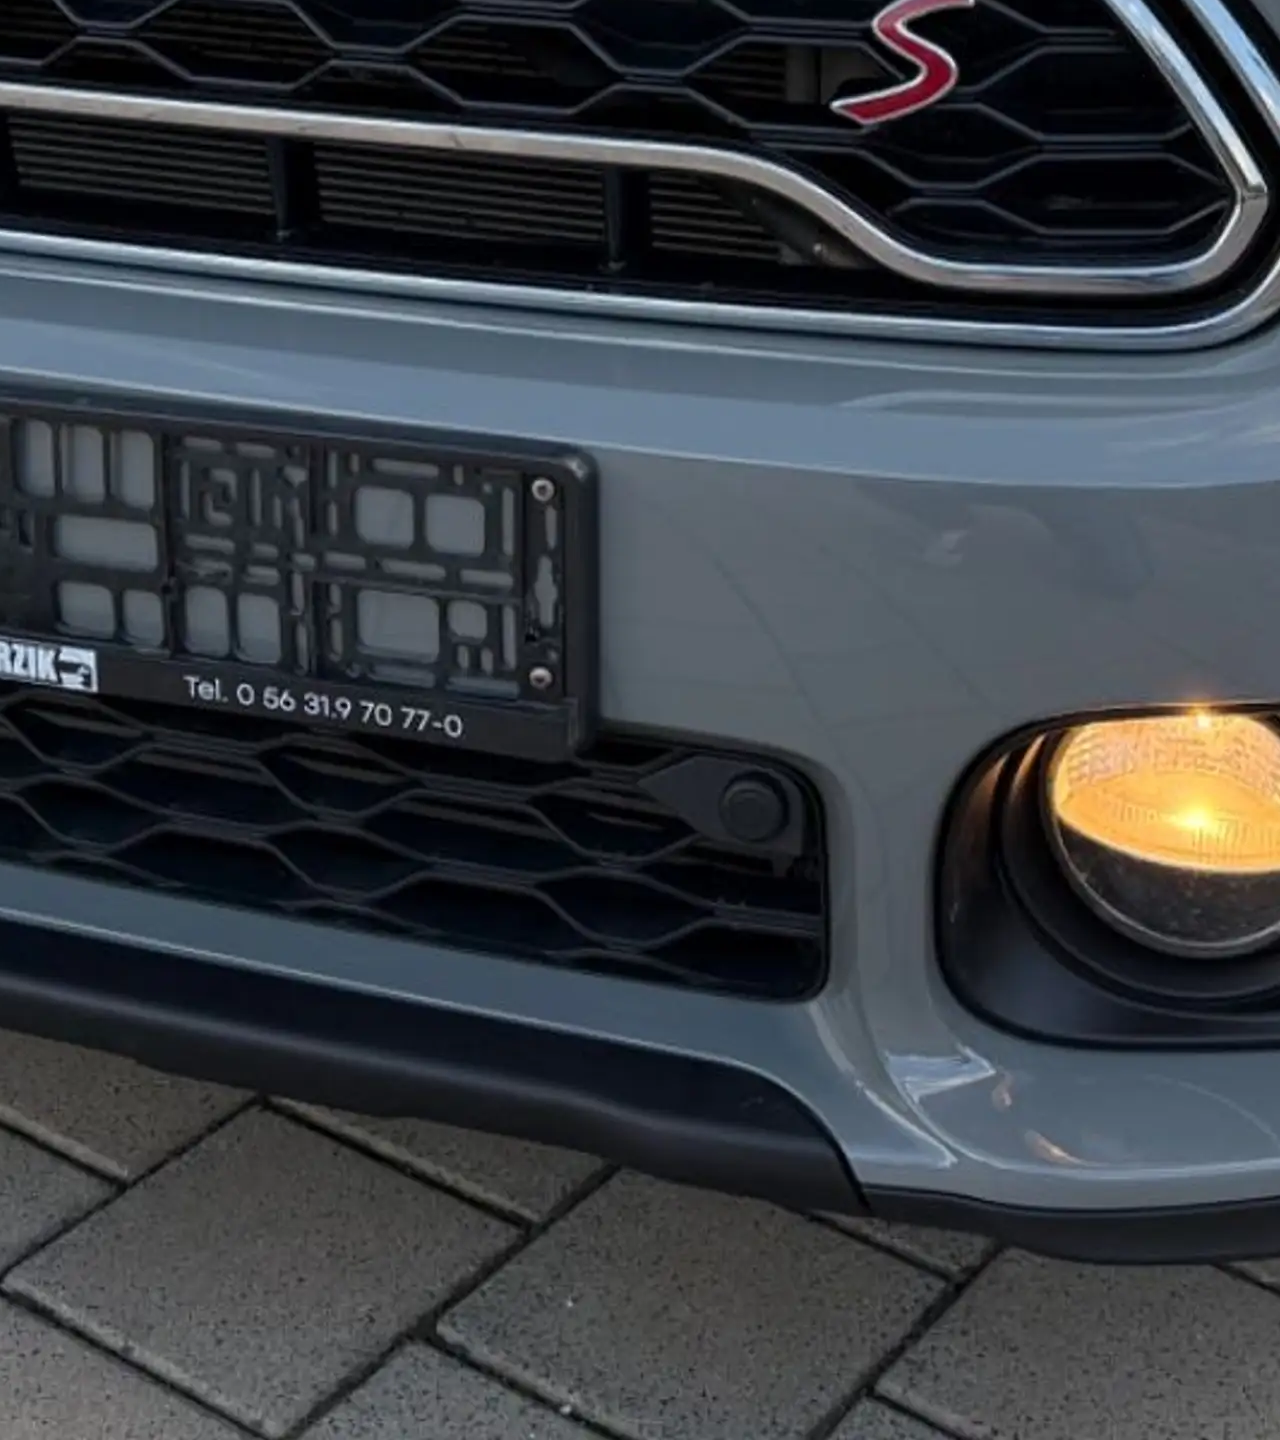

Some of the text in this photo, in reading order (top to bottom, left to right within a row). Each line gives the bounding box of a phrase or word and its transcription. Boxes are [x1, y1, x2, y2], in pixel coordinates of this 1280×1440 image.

[184, 676, 228, 702] Tel.
[236, 683, 255, 706] 0
[263, 687, 296, 712] 56
[360, 700, 393, 727] 70
[401, 707, 463, 738] 77-0
